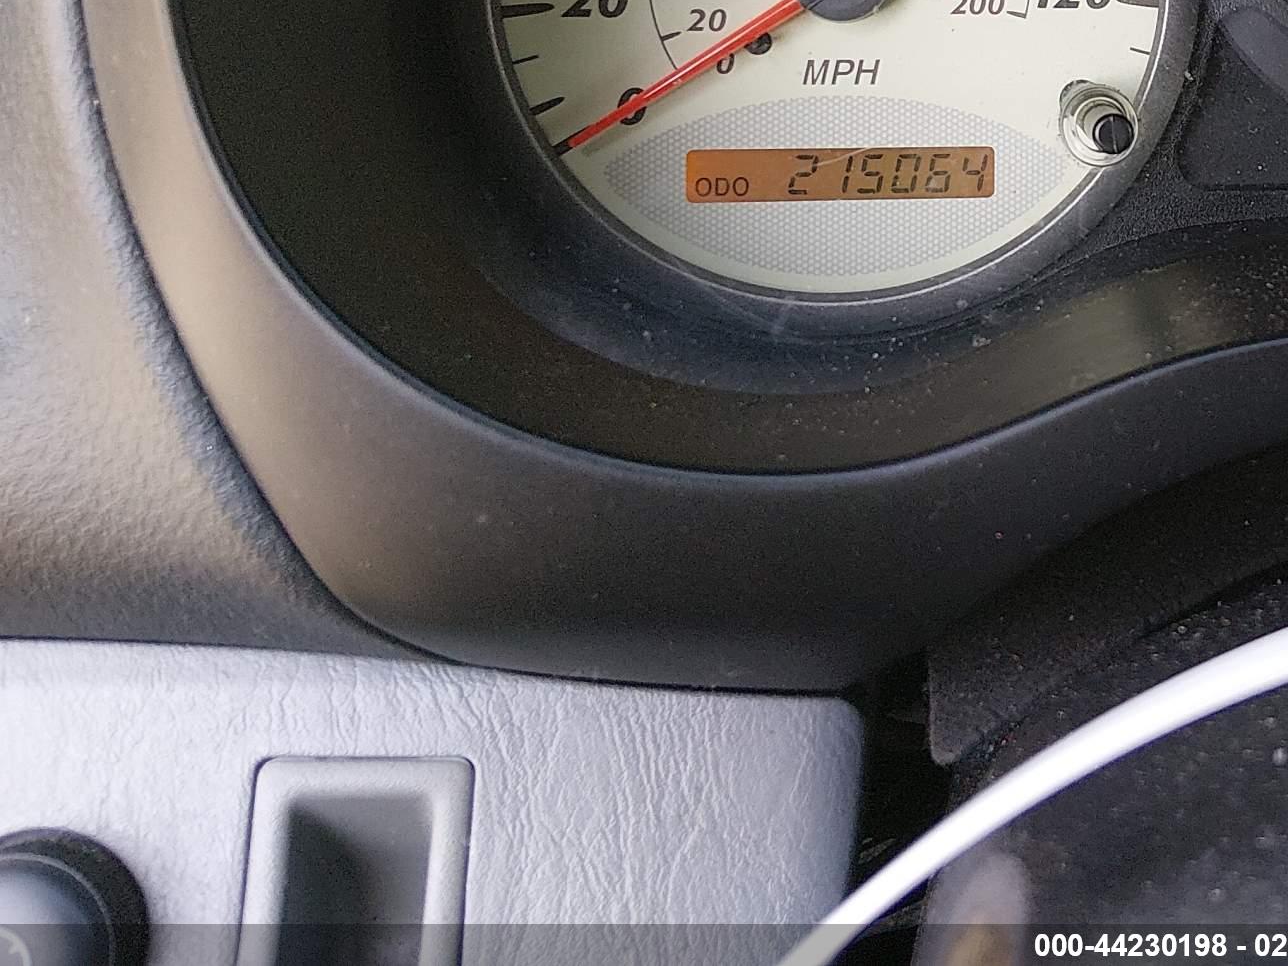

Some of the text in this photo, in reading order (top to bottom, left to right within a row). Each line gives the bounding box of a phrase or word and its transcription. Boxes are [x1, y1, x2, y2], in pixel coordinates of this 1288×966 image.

[686, 8, 727, 32] 20
[716, 52, 735, 75] 0
[803, 59, 881, 86] MPH
[695, 152, 989, 197] ODO 215064
